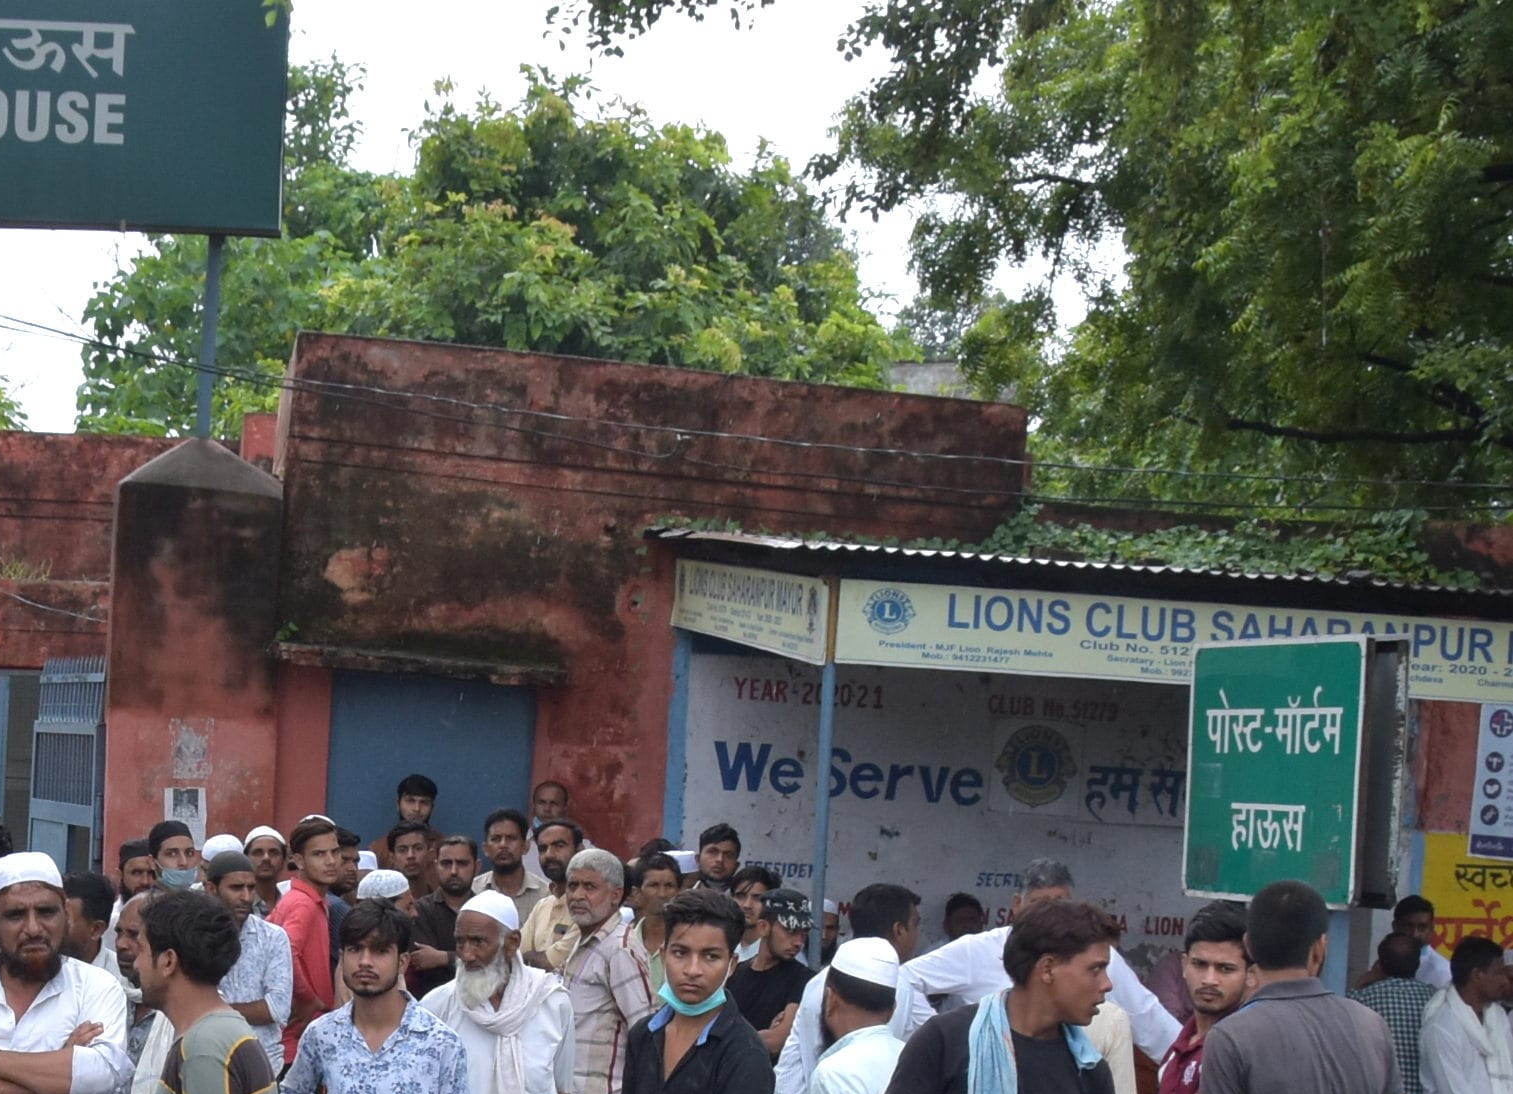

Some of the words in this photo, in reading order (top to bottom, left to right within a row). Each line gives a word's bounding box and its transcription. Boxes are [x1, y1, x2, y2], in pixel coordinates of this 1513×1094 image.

[948, 593, 1071, 635] LIONS
[1086, 602, 1196, 643] CLUB
[878, 640, 927, 651] President
[959, 645, 981, 654] Lion
[1080, 640, 1119, 652] Club
[1126, 643, 1154, 654] No.
[1159, 646, 1193, 657] 512
[1411, 663, 1442, 673] ear:
[1449, 664, 1487, 675] 2020
[988, 694, 1034, 716] CLUB
[1206, 685, 1344, 755] पोस्ट-मॉर्टम
[713, 740, 805, 796] We
[827, 747, 984, 806] Serve
[1084, 764, 1143, 822] हम
[1231, 802, 1306, 852] हाऊस
[1144, 915, 1185, 937] LION
